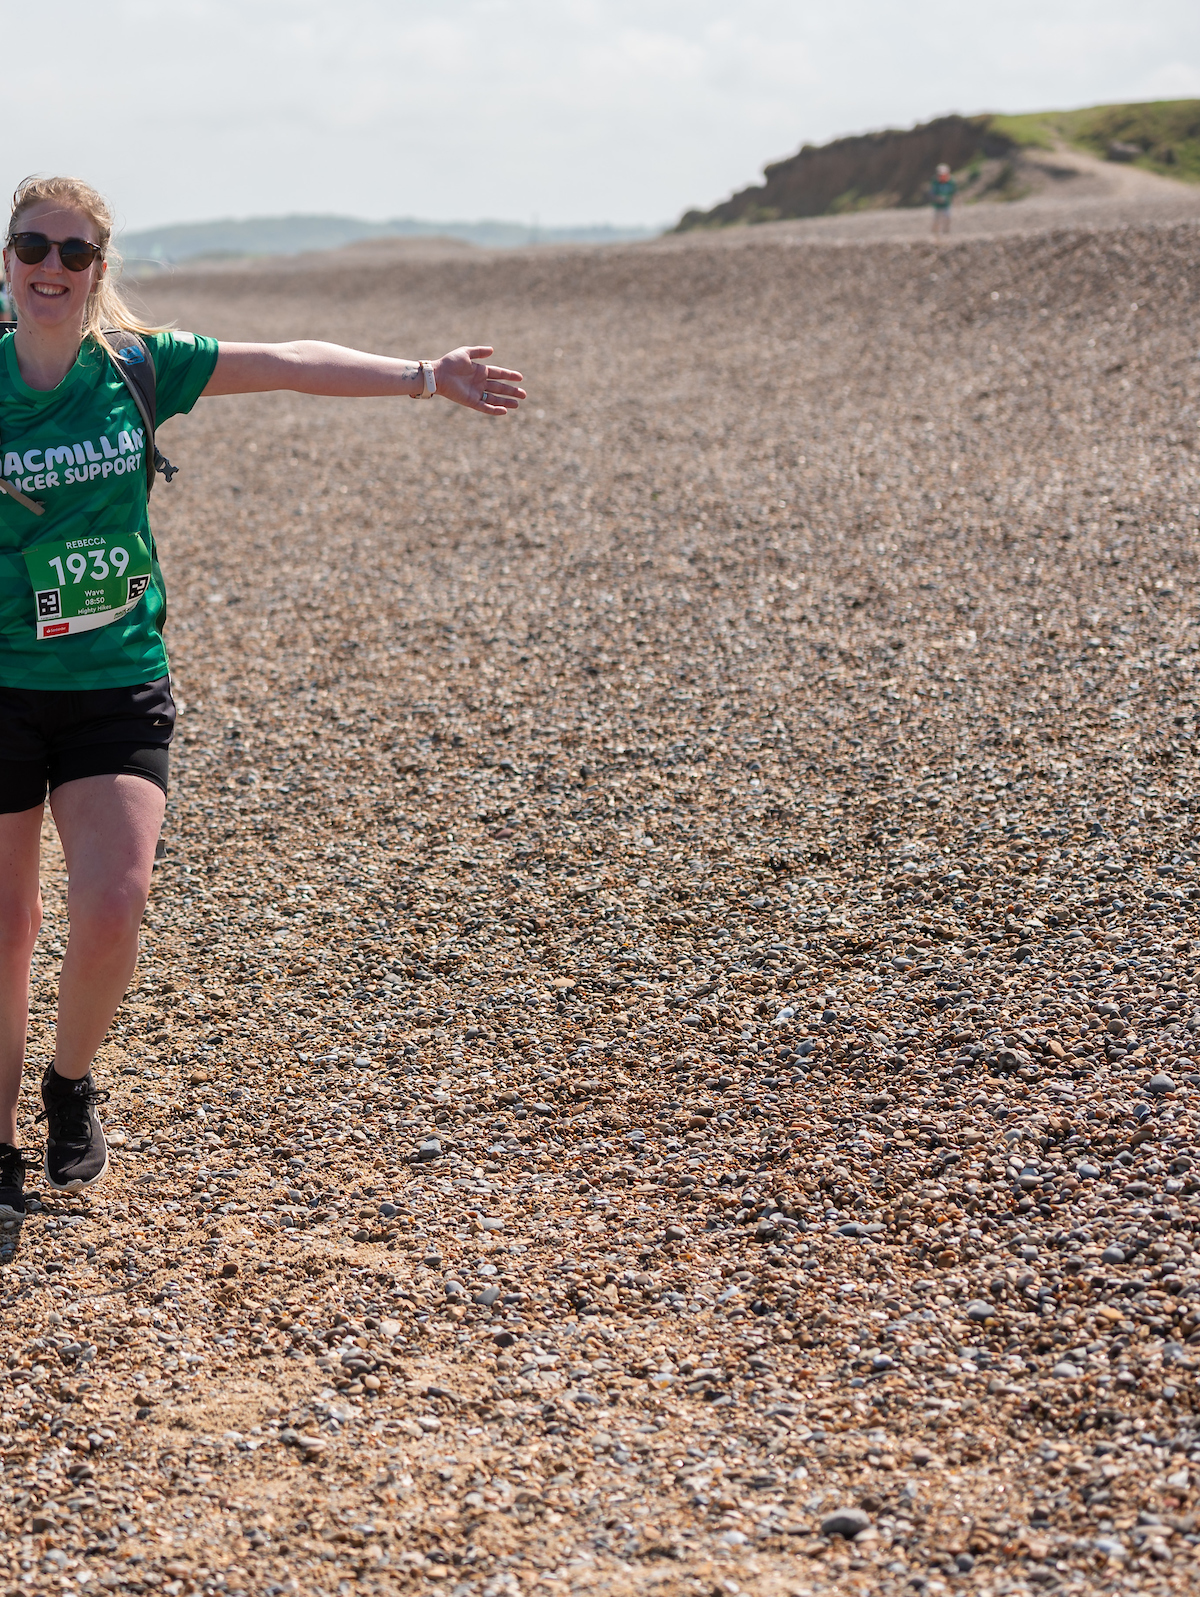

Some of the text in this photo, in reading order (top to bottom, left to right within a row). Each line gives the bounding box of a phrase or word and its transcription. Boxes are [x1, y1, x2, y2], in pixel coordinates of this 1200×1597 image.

[64, 453, 141, 485] SUPPORT
[66, 537, 106, 549] REBECCA
[48, 547, 129, 586] 1939
[84, 589, 105, 597] Wave
[85, 596, 105, 606] 08:50
[77, 607, 96, 615] Mighty
